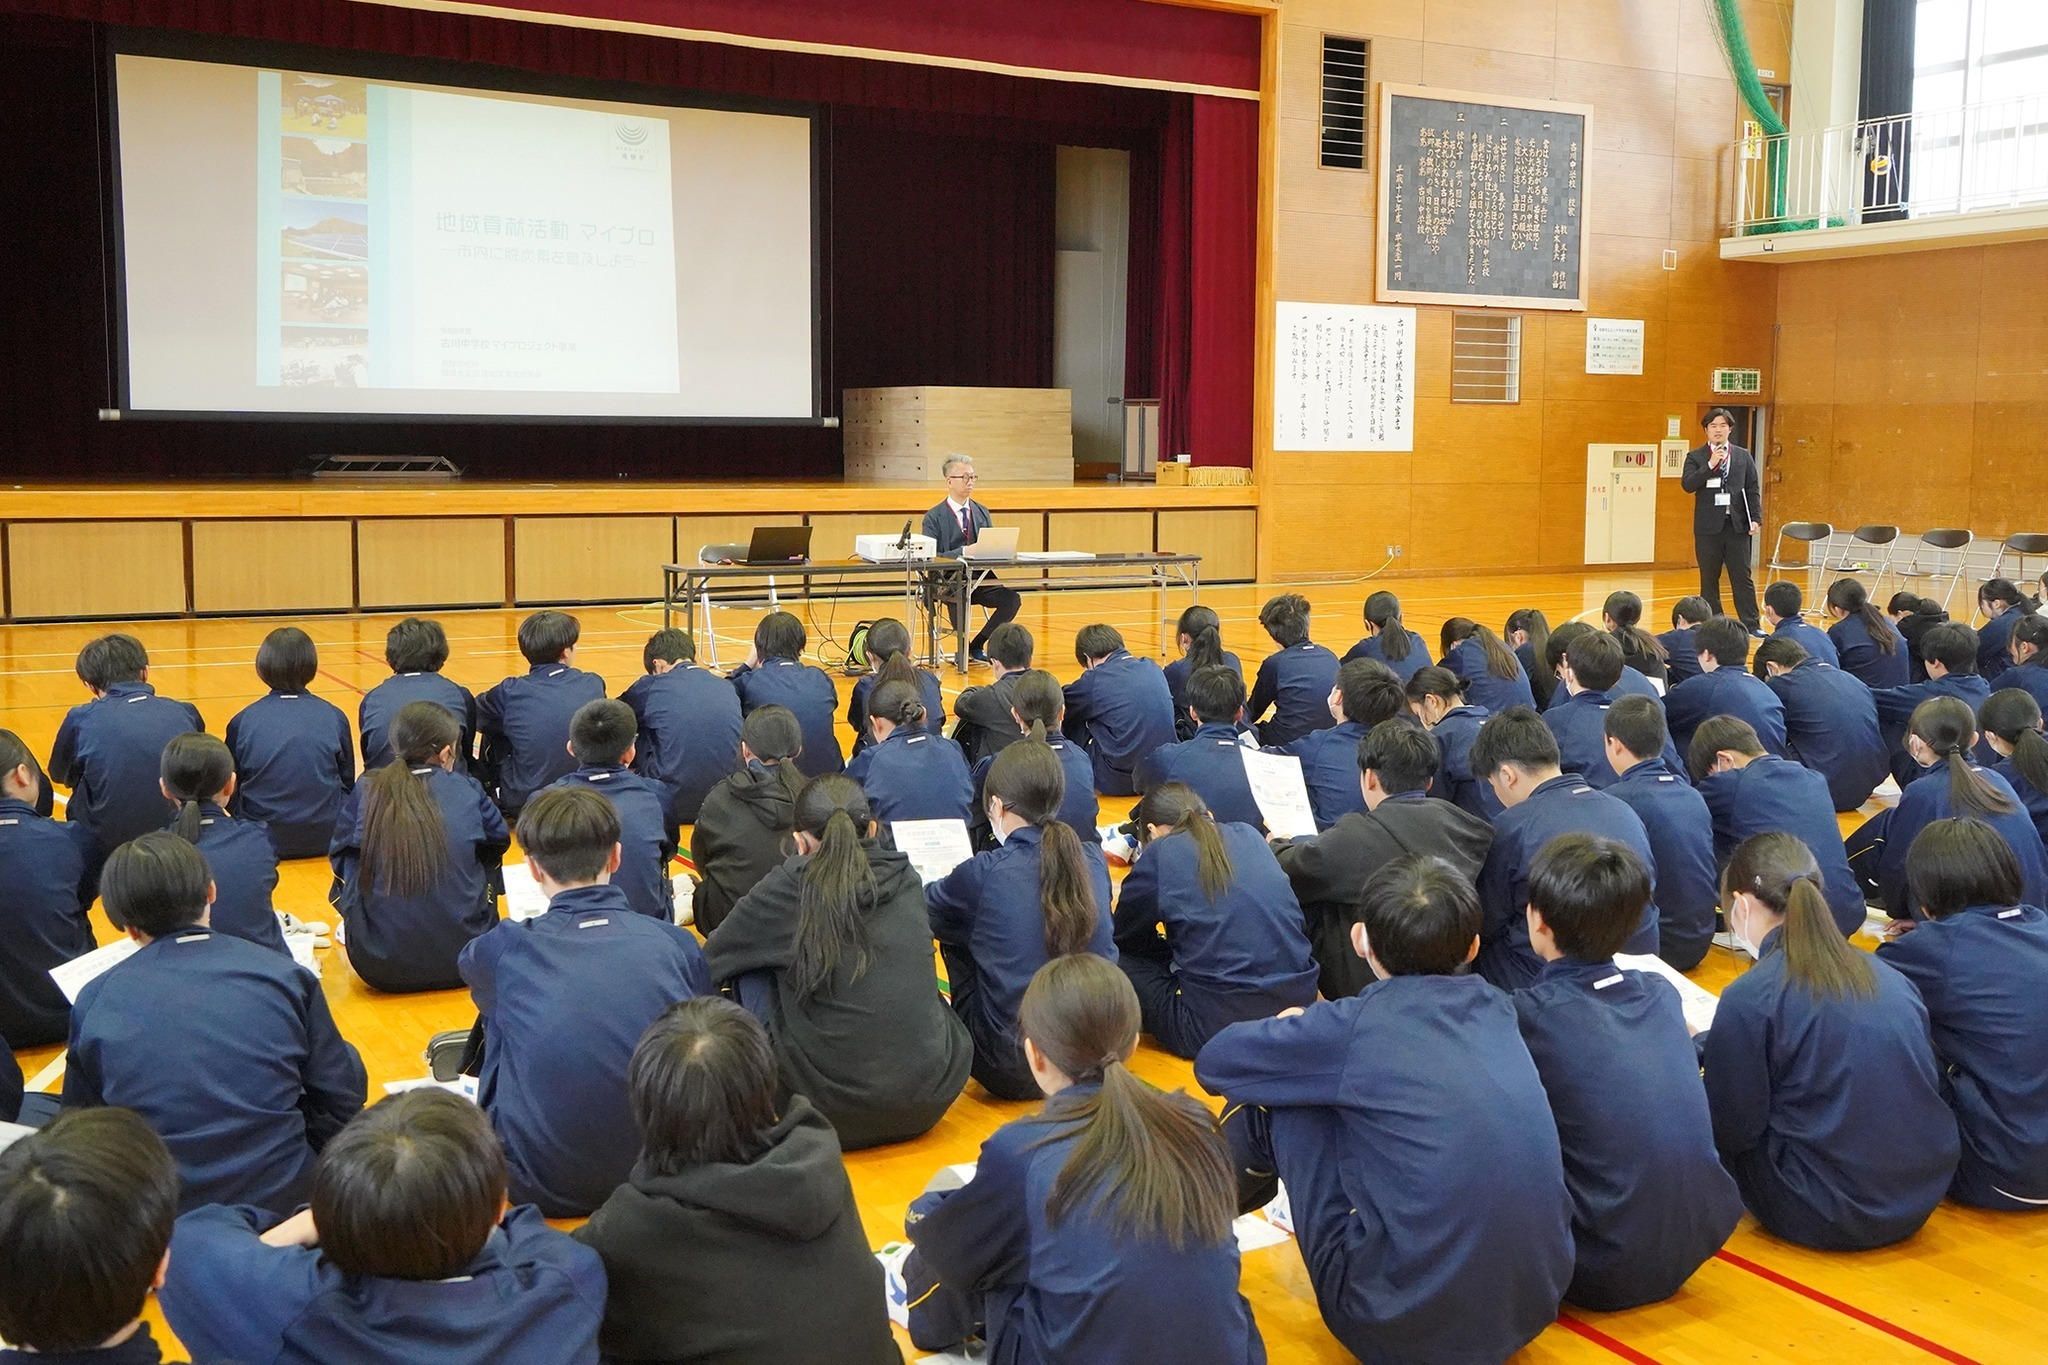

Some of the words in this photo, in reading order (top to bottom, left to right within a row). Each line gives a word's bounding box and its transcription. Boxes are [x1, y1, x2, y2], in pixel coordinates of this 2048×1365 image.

[1457, 113, 1465, 122] 三
[1500, 118, 1508, 126] 二
[1568, 142, 1577, 188] 古川中学校
[1417, 186, 1425, 234] 古川中学校
[436, 211, 569, 241] 地域貢献活動
